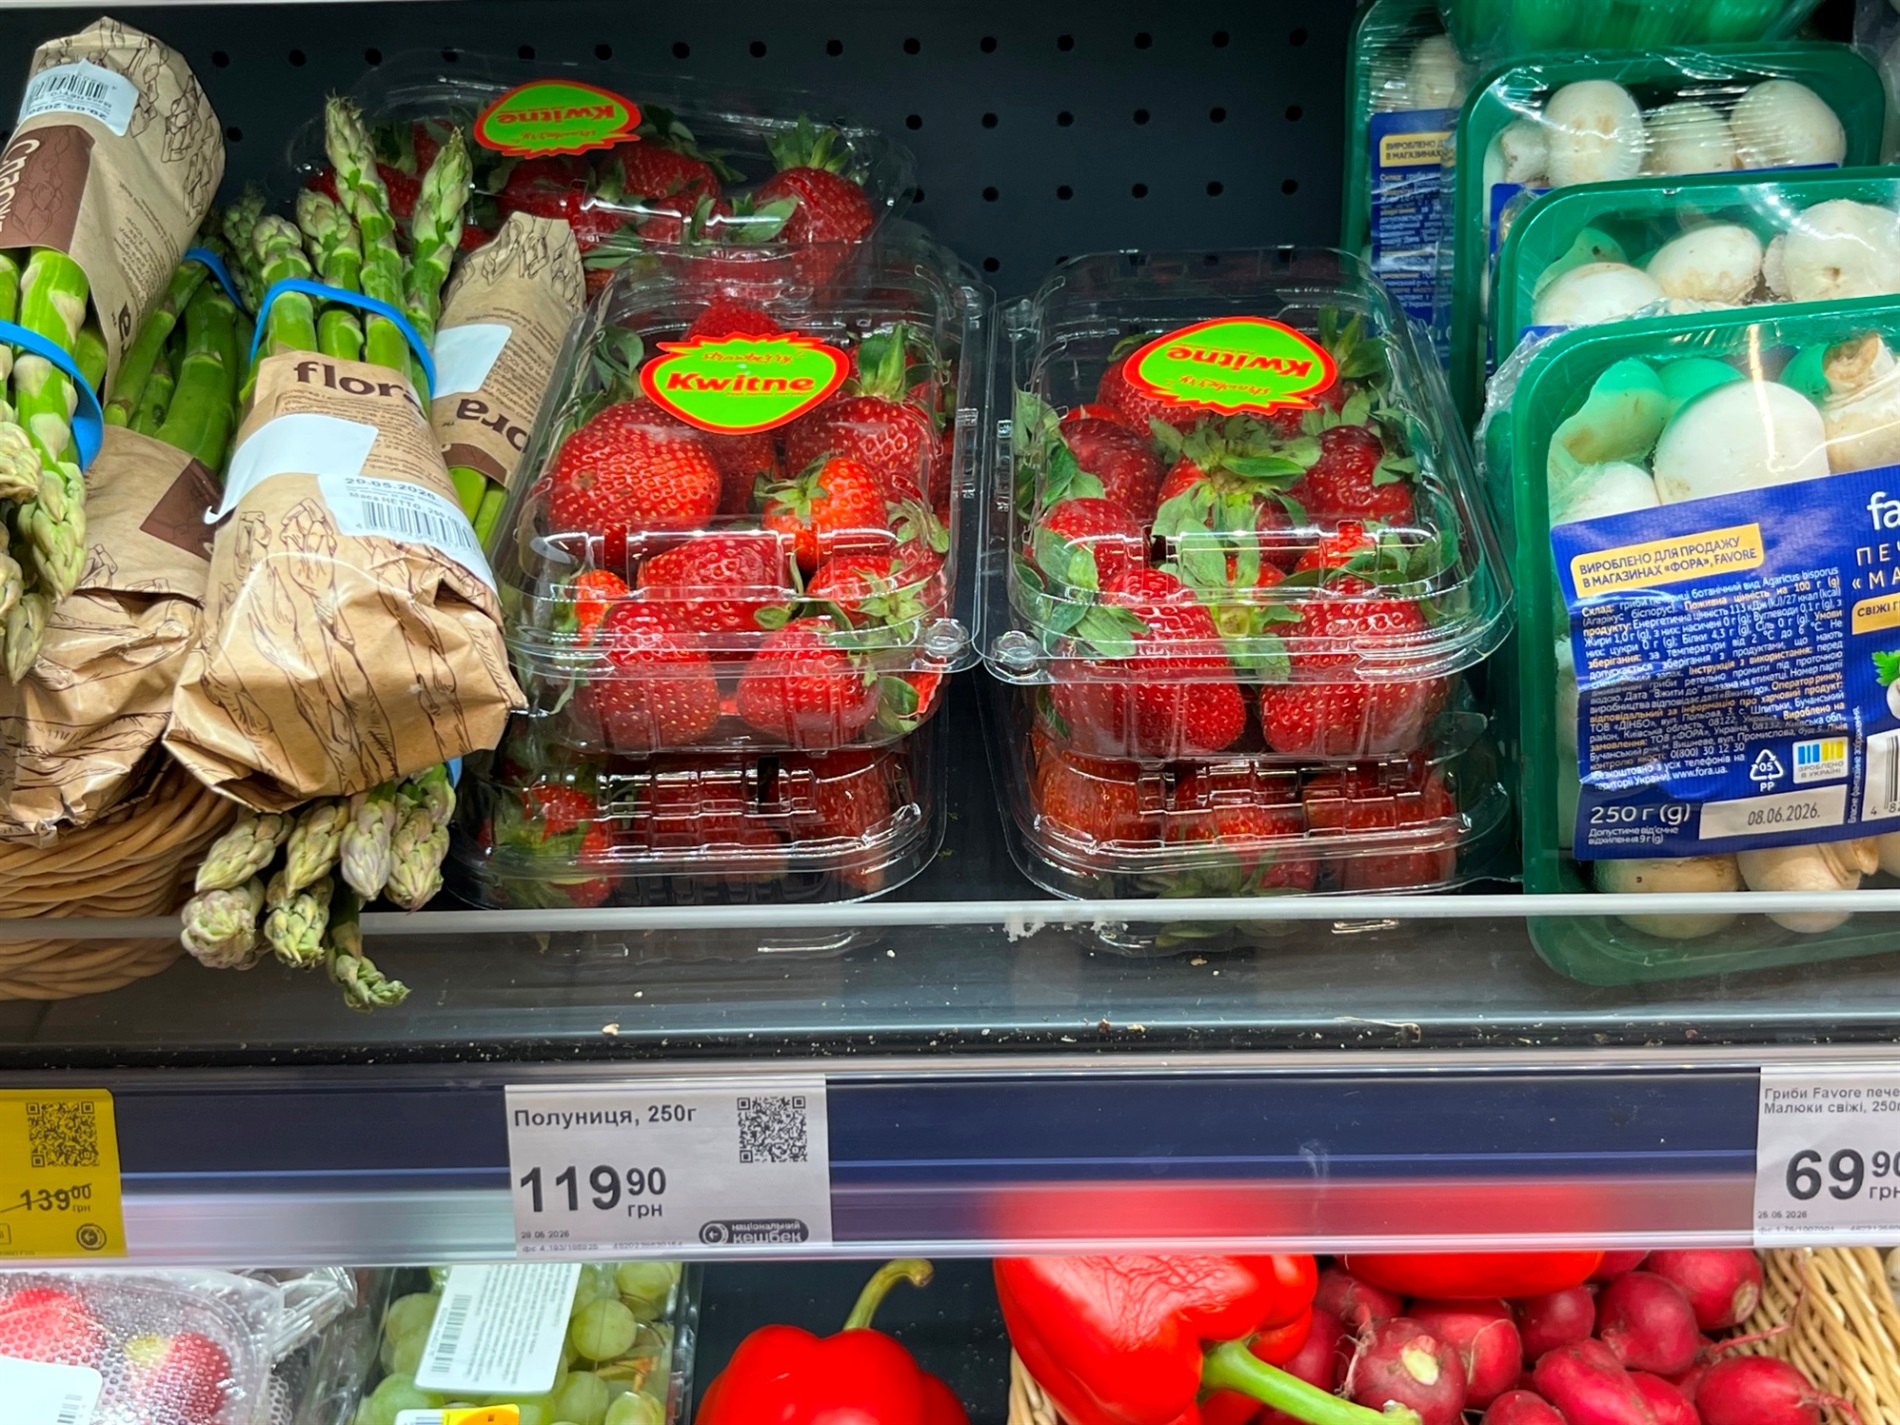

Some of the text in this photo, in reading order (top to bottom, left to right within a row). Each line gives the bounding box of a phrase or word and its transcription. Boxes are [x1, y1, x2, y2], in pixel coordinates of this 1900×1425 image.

[497, 105, 615, 123] Kwitne
[702, 352, 793, 364] strawberry
[1166, 346, 1314, 378] Kwitne
[666, 373, 815, 392] Kwitne
[1580, 537, 1740, 575] ВИРОБЛЕНО ДЛЯ ПРОДАЖУ
[1856, 541, 1900, 566] ПЕ
[1583, 548, 1757, 588] В МАГАЗИНАХ «ФОРА», FAVORE
[1582, 567, 1839, 617] Склад: ботанічний вид Agaricus bisporus
[1684, 596, 1727, 611] Поживна
[1734, 591, 1770, 603] цінність
[1776, 587, 1788, 595] на
[1794, 582, 1811, 592] 100
[1583, 623, 1632, 637] продукту:
[1633, 613, 1692, 629] Енергетична
[1693, 606, 1729, 620] цінність
[1730, 603, 1746, 614] 113
[1747, 601, 1767, 612] кДж
[1798, 592, 1818, 602] ккал
[1820, 587, 1840, 599] (kcal)
[1857, 602, 1891, 617] СВІЖІ
[1584, 637, 1612, 647] Жири
[1661, 627, 1680, 636] них
[1682, 618, 1722, 633] насичені
[1753, 606, 1798, 622] Вуглеводи
[1586, 610, 1842, 658] них цукри Білки 4,3 Сіль Умови
[1588, 620, 1843, 669] зберігання: за температури від до Не
[1662, 632, 1843, 670] зберігання продуктами, що мають
[1689, 642, 1843, 674] Інструкція використання: перед
[1684, 651, 1842, 688] ретельно промити під проточною
[1790, 665, 1818, 678] Номер
[1820, 661, 1843, 672] партії
[1772, 676, 1814, 690] Оператор
[1815, 671, 1842, 684] ринку,
[1590, 709, 1663, 724] відповідальний
[1740, 698, 1757, 707] про
[1761, 689, 1800, 703] харчовий
[1804, 682, 1843, 695] продукт:
[1590, 722, 1610, 732] ТОВ
[1750, 701, 1792, 714] Шпитьки,
[1794, 690, 1844, 708] Бучанський
[1783, 705, 1831, 720] Вироблено
[1834, 702, 1845, 710] на
[1590, 739, 1647, 751] замовлення:
[1651, 734, 1670, 743] ТОВ
[1670, 748, 1698, 759] 0(800)
[1703, 746, 1714, 755] 30
[1719, 744, 1729, 753] 12
[1733, 742, 1745, 752] 30
[1685, 753, 1730, 767] телефонів
[1759, 762, 1773, 772] 05
[1798, 761, 1844, 772] ЗРОБЛЕНО
[1672, 765, 1727, 779] www.fora.ua.
[1809, 768, 1840, 777] УКРАЇНІ
[1760, 782, 1774, 792] PP
[1590, 803, 1691, 825] 250 г (g)
[1747, 802, 1821, 826] 08.06.2026.
[1870, 806, 1877, 815] 4
[1588, 828, 1639, 837] Допустиме
[1588, 836, 1638, 845] відхилення
[1764, 1088, 1807, 1100] Гриби
[1813, 1088, 1861, 1099] Favore
[514, 1104, 697, 1130] Полуниця, 250г
[1764, 1102, 1822, 1114] Малюки
[1828, 1102, 1867, 1114] свіжі,
[1786, 1149, 1864, 1201] 69
[20, 1185, 91, 1211] 139 00
[520, 1164, 667, 1213] 119 90
[73, 1205, 90, 1213] грн
[628, 1204, 663, 1219] грн
[732, 1221, 801, 1231] національний
[733, 1230, 802, 1244] кешбек
